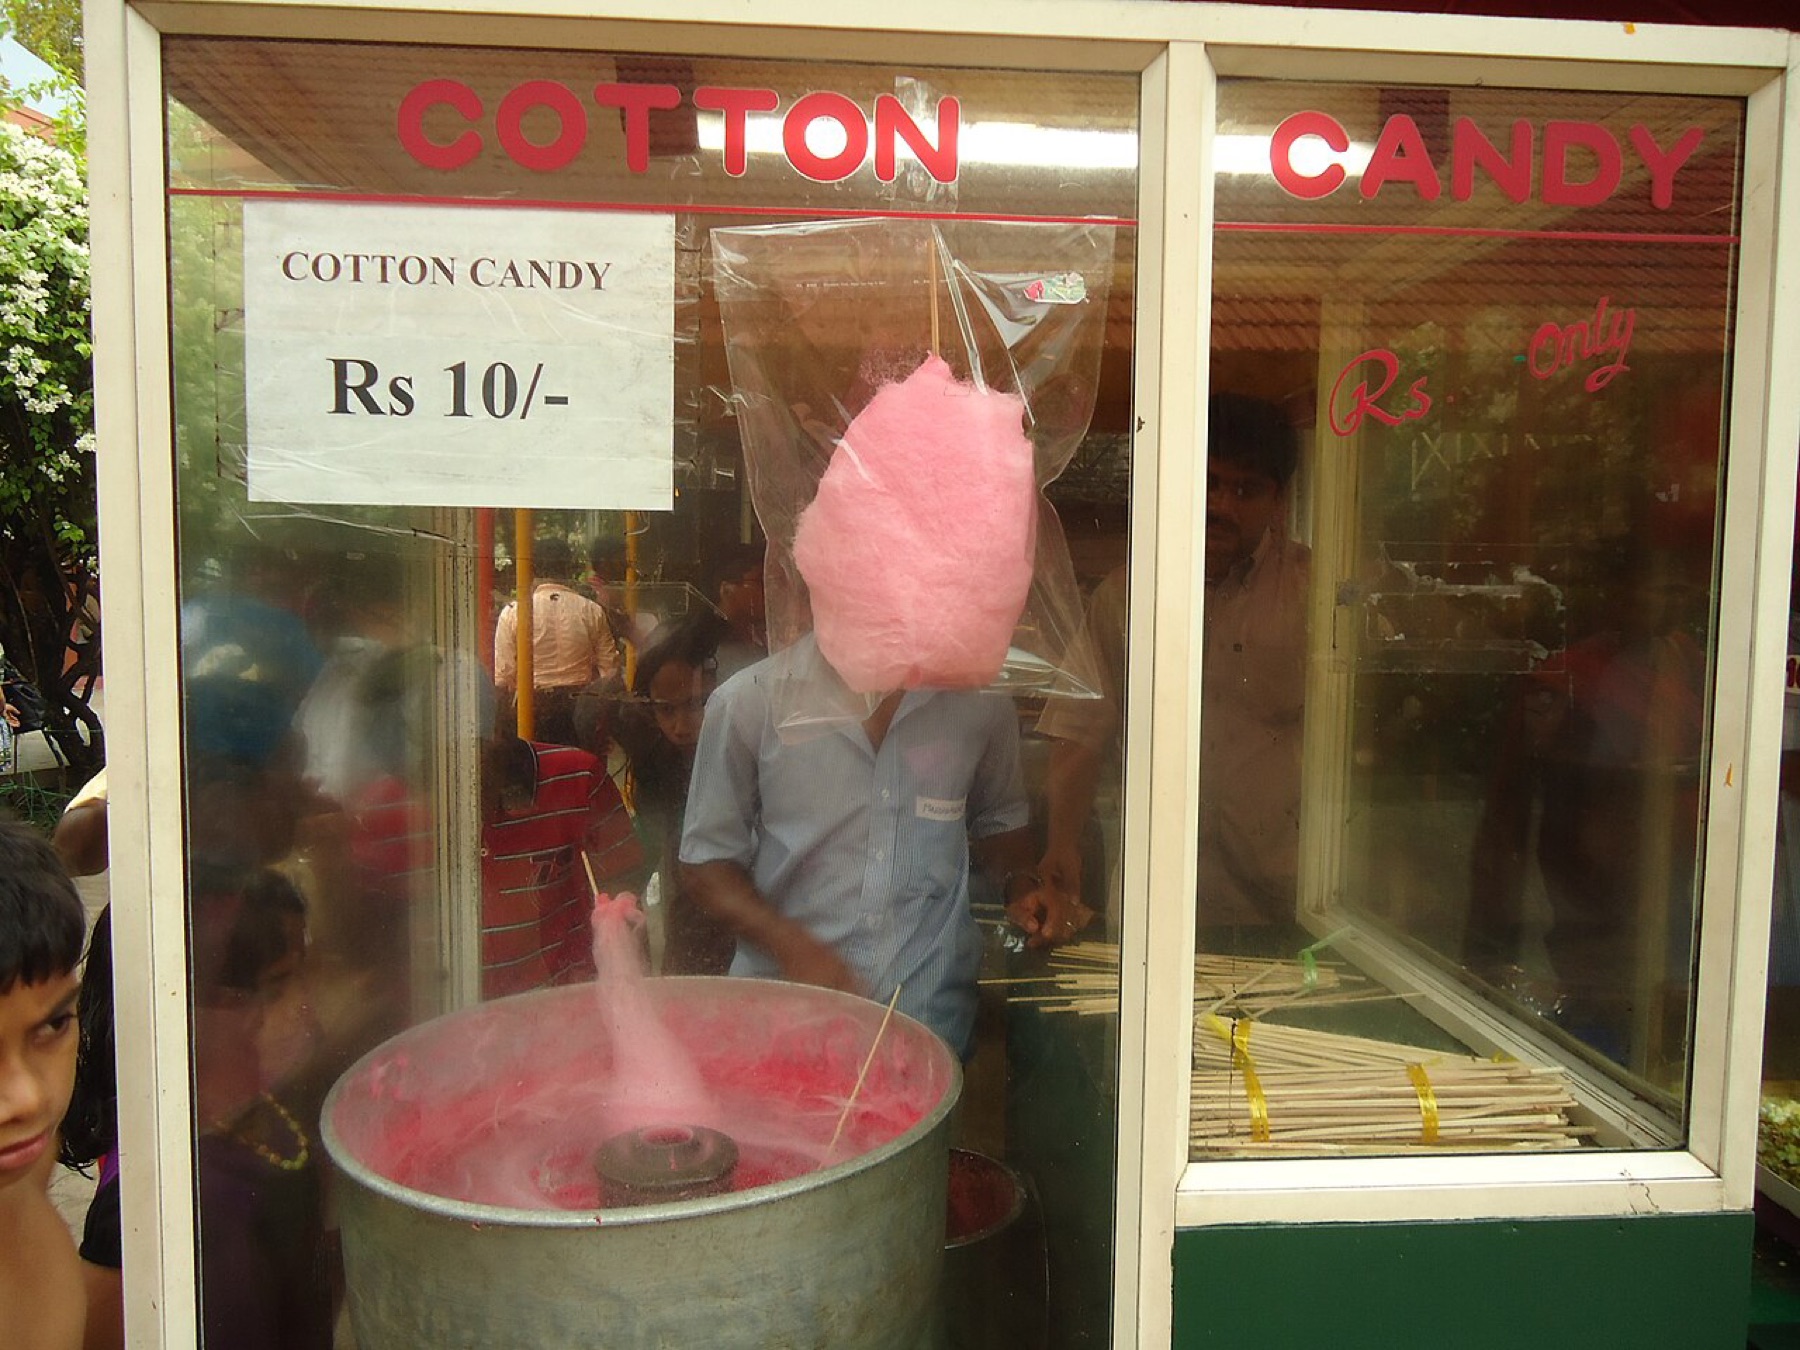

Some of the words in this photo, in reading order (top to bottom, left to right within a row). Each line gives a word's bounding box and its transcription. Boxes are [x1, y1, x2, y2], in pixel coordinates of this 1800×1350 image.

[397, 78, 961, 185] COTTON
[1269, 110, 1706, 209] CANDY
[282, 251, 456, 287] COTTON
[469, 257, 612, 291] CANDY
[1527, 296, 1635, 393] Only
[325, 357, 415, 417] Rs
[443, 361, 569, 420] 10/-
